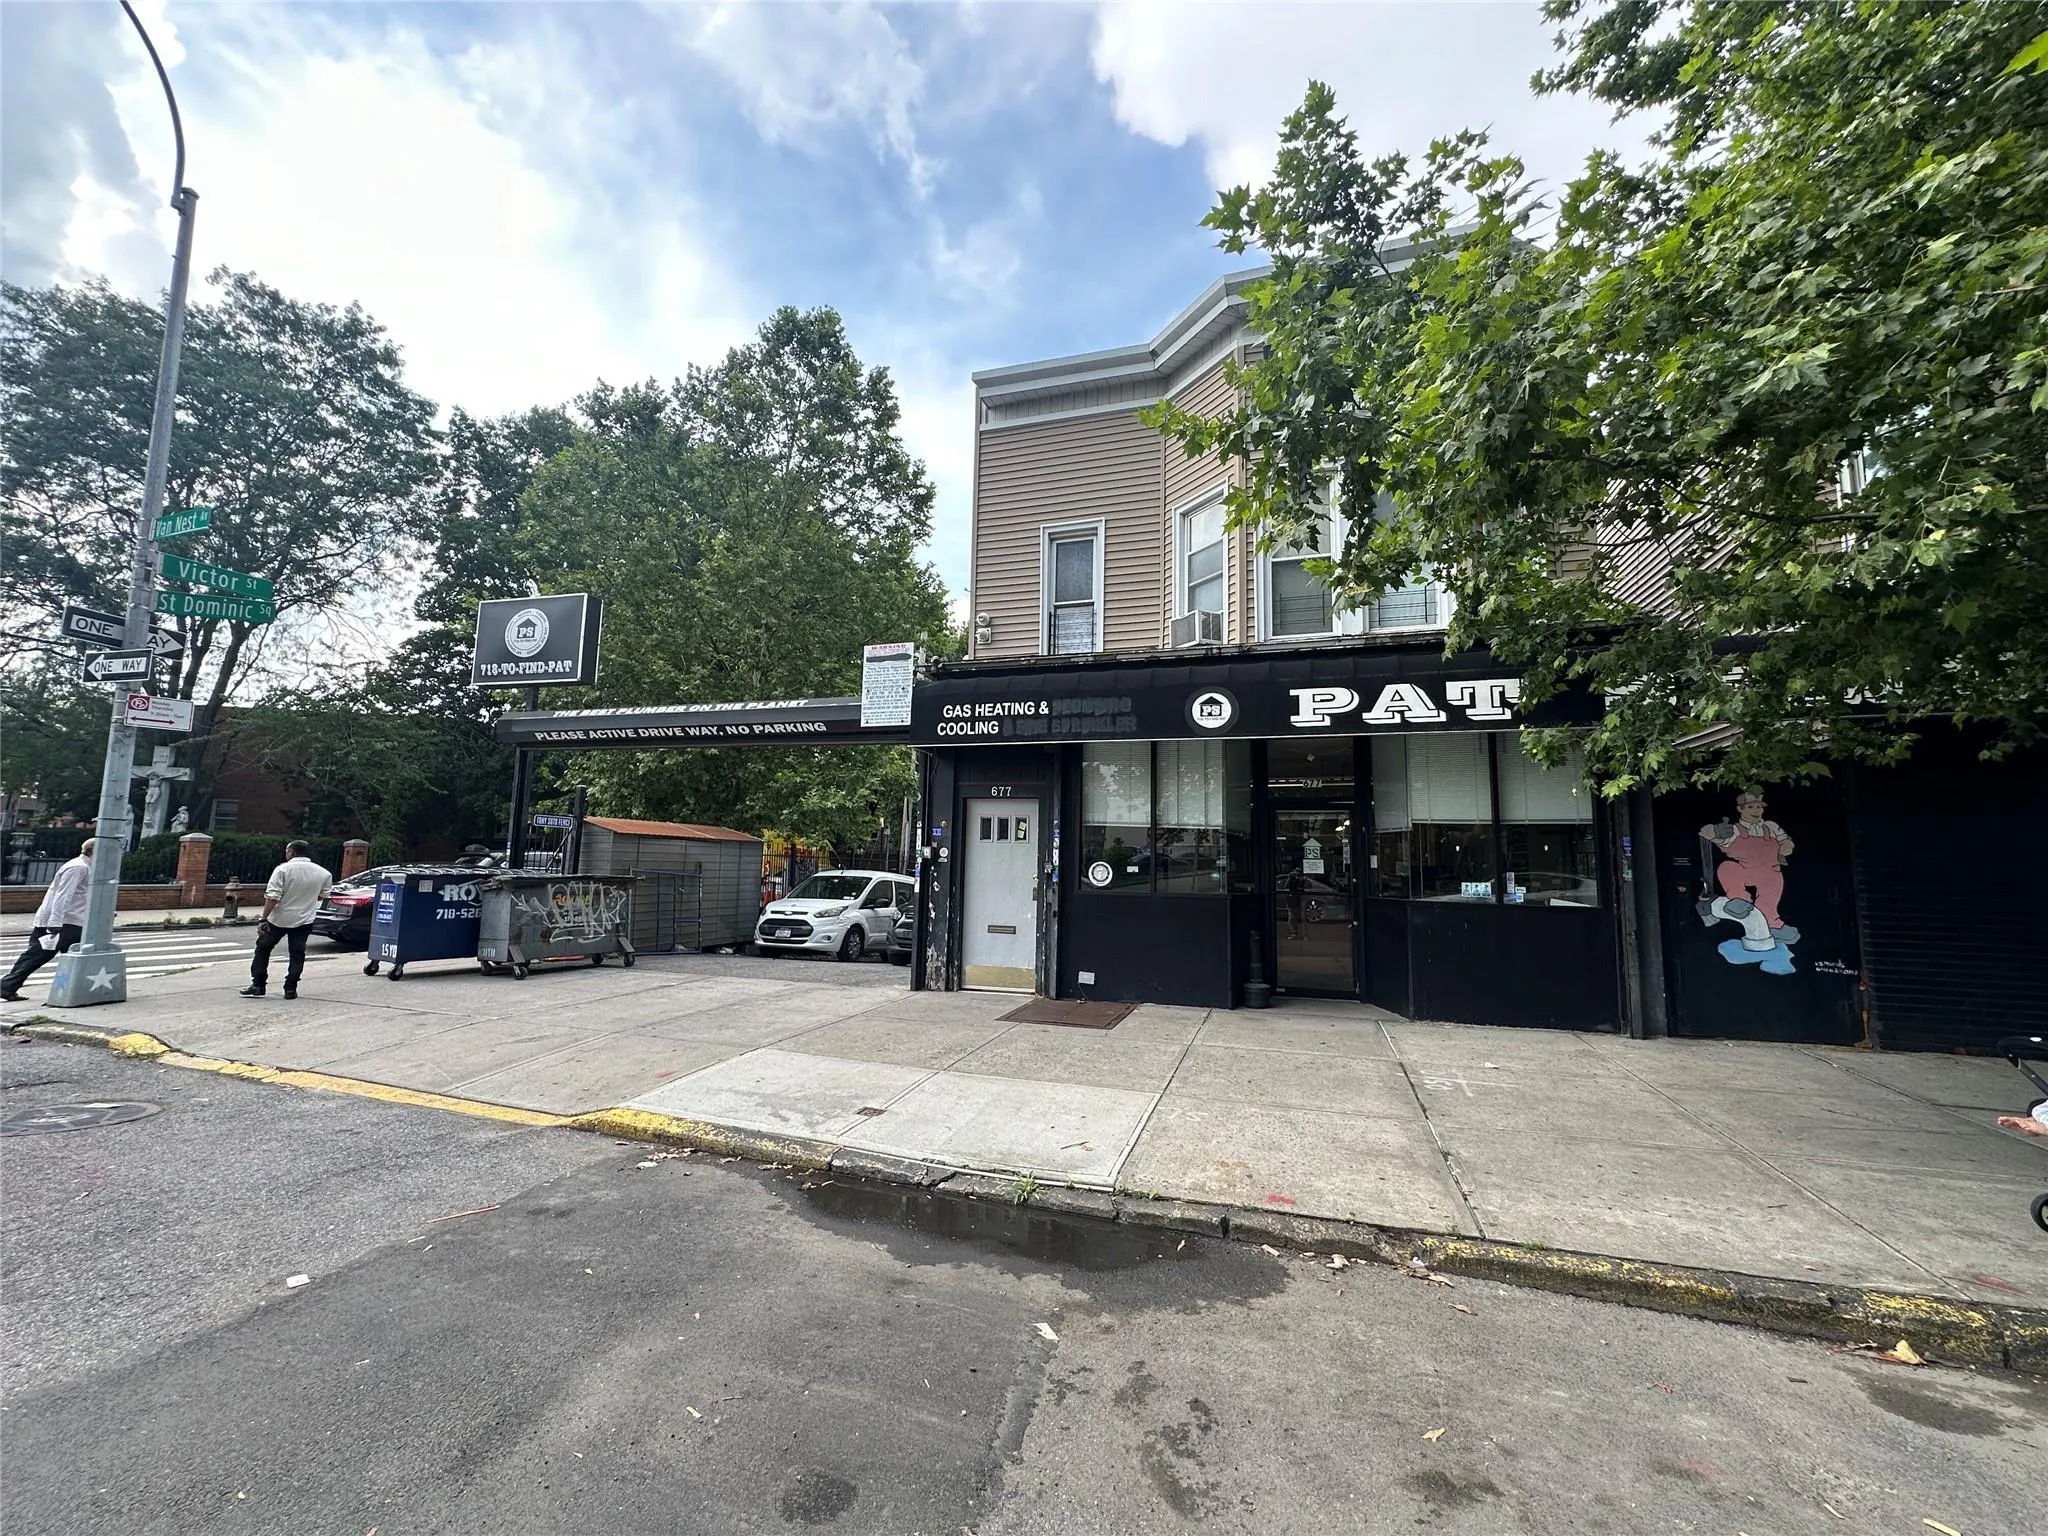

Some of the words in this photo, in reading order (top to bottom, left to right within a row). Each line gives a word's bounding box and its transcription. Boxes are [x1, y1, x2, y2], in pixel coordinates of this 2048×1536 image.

[156, 519, 173, 537] Van
[174, 512, 197, 531] Nest
[180, 560, 239, 590] Victor
[246, 578, 257, 590] St
[158, 593, 177, 611] St
[183, 596, 253, 619] Dominic
[260, 604, 272, 617] Sq
[75, 618, 114, 636] ONE
[146, 635, 171, 649] AY
[518, 626, 535, 638] PS
[93, 661, 114, 673] ONE
[122, 659, 143, 671] WAY
[480, 660, 573, 676] 718-TO-FIND-PAT
[553, 709, 580, 718] THE
[580, 708, 616, 716] BEST
[615, 704, 685, 715] PLUMBER
[688, 704, 712, 712] ON
[713, 702, 743, 711] THE
[745, 699, 809, 710] PLANET
[943, 704, 972, 718] GAS
[975, 701, 1035, 717] HEATING
[1038, 701, 1050, 714] &
[1201, 705, 1221, 716] PS
[1289, 678, 1526, 728] PAT
[534, 730, 587, 741] PLEASE
[589, 728, 637, 739] ACTIVE
[637, 726, 685, 738] DRIVE
[685, 725, 724, 736] WAY,
[725, 724, 751, 735] NO
[752, 722, 827, 734] PARKING
[937, 721, 999, 736] COOLING
[991, 786, 1012, 797] 677
[1305, 848, 1319, 857] PS
[443, 884, 481, 902] RO
